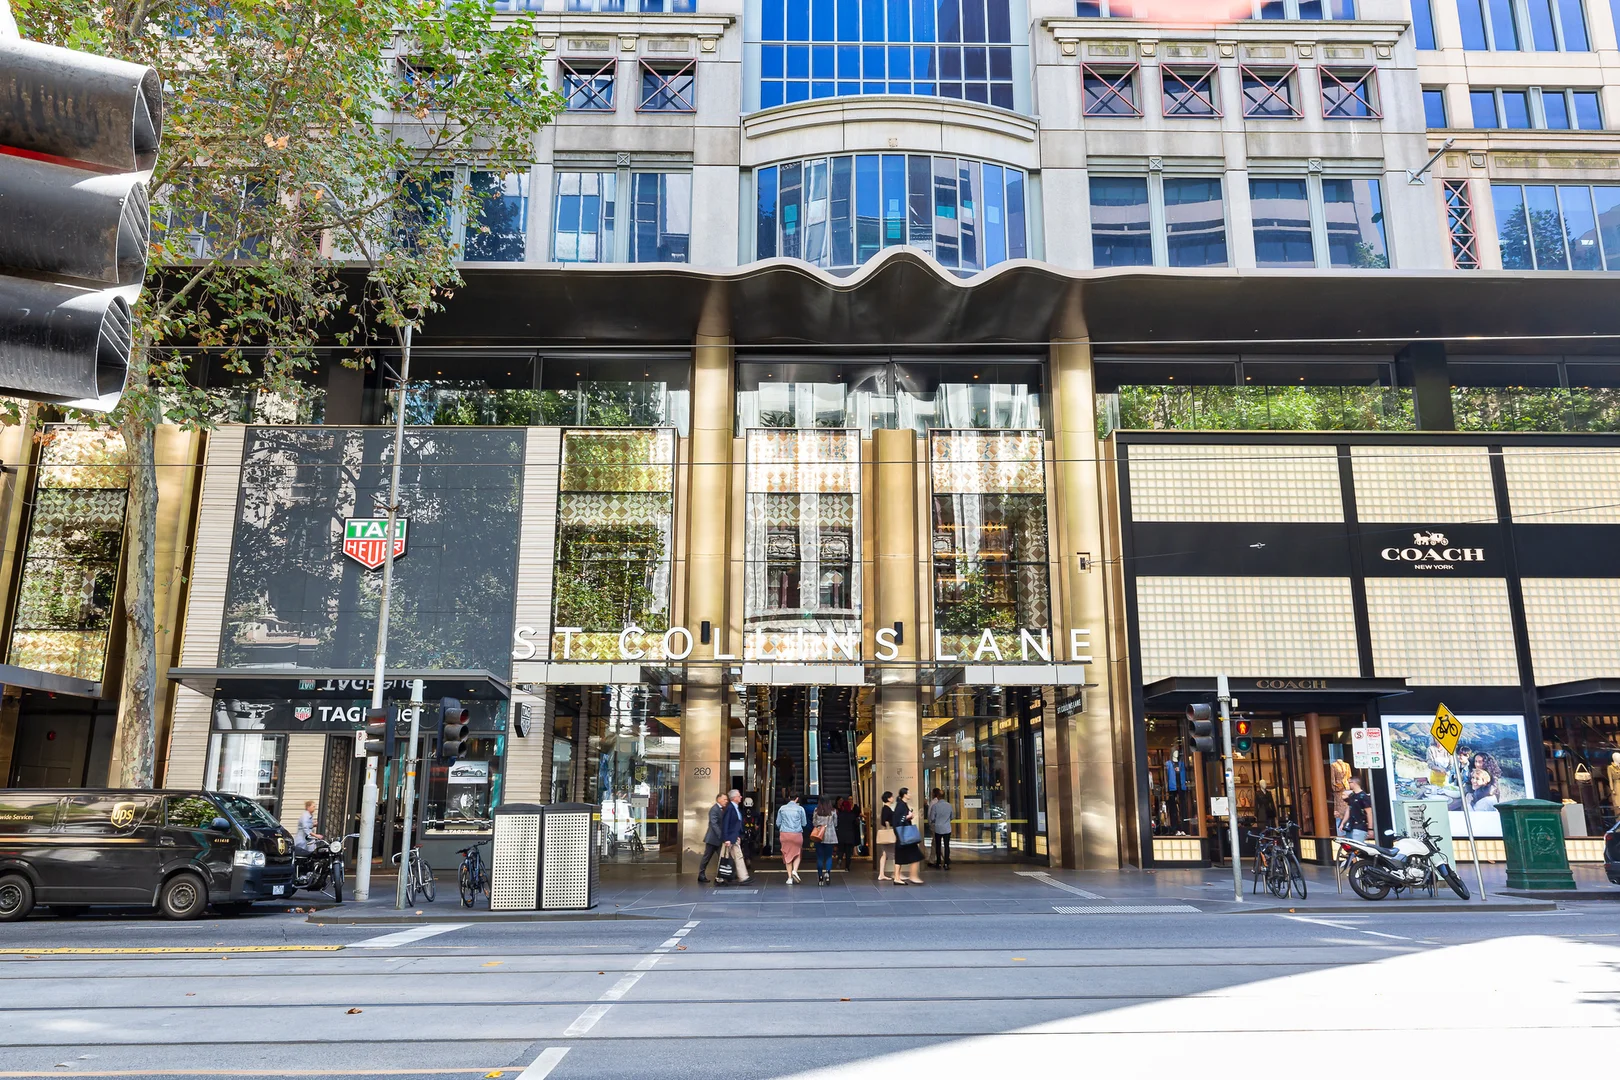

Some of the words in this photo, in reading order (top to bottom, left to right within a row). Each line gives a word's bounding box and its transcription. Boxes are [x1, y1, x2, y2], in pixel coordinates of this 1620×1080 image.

[1381, 548, 1485, 561] COACH
[619, 626, 898, 661] COLLINS
[935, 628, 1092, 661] LANE
[1256, 680, 1327, 689] COACH
[694, 767, 711, 776] 260
[113, 810, 133, 823] ups
